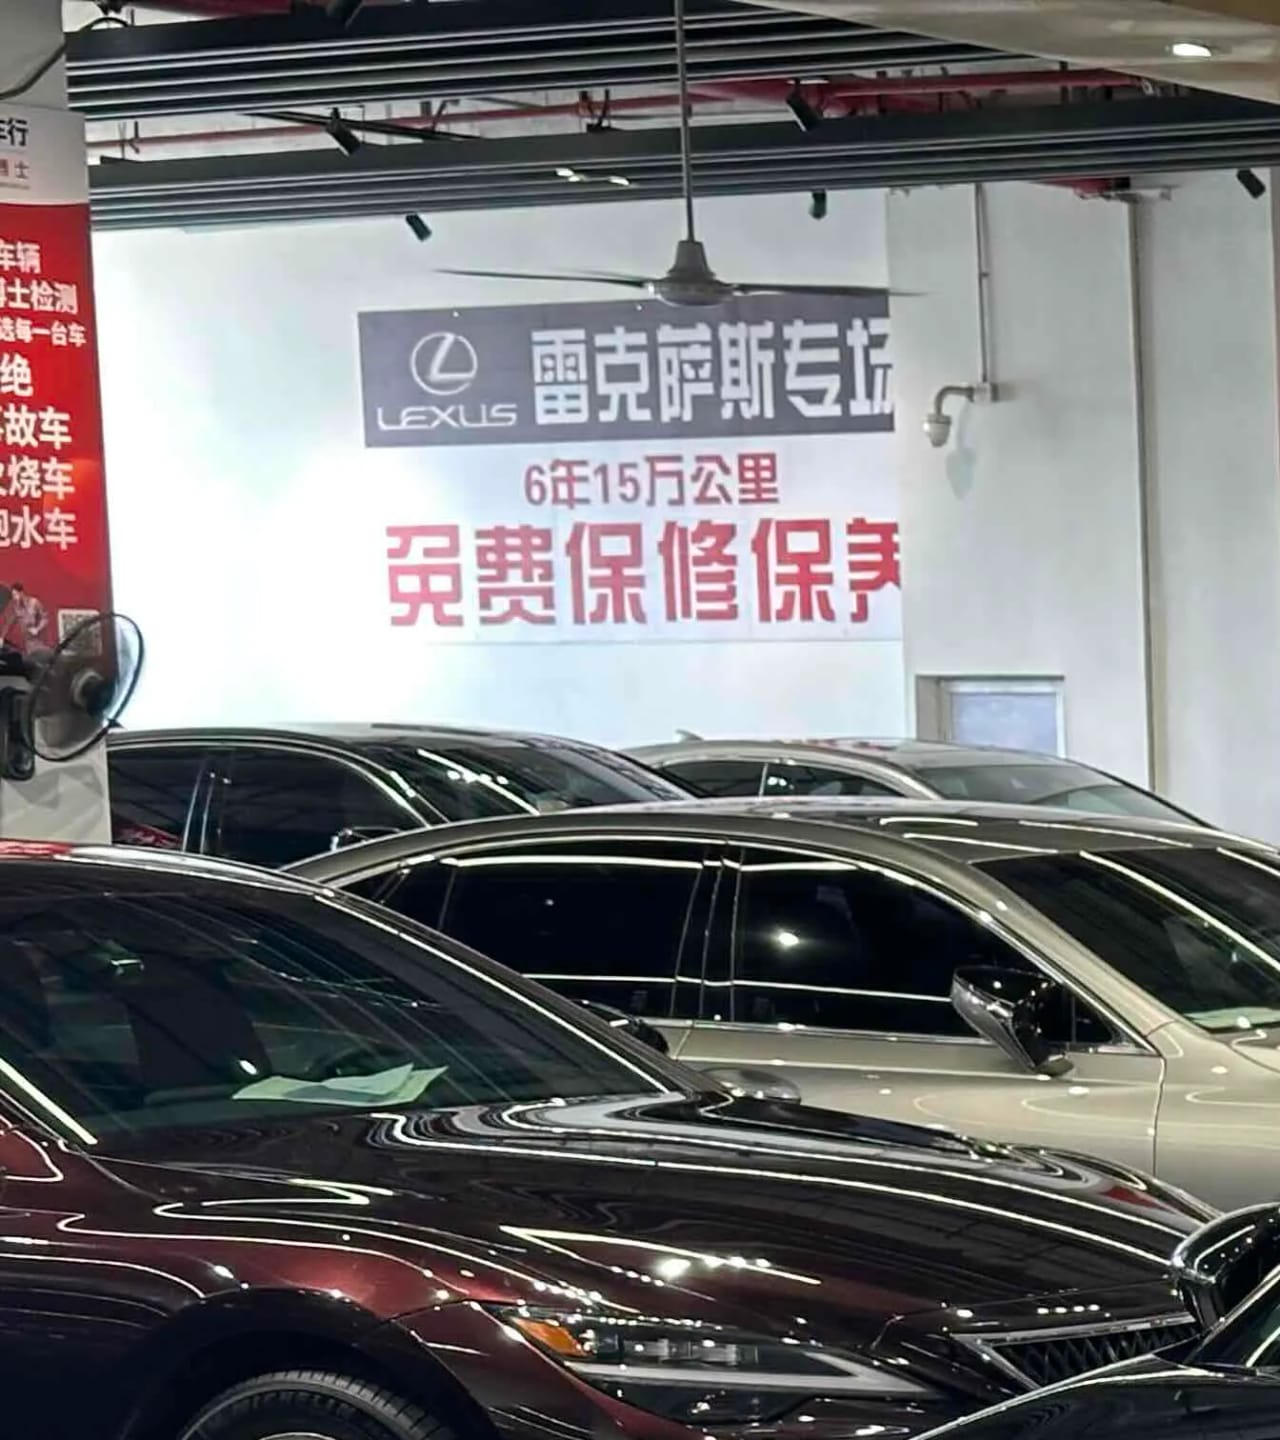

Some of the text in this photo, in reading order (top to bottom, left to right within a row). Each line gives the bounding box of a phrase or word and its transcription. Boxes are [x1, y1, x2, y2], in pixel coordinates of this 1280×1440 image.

[531, 317, 894, 425] 雷克萨斯专场
[0, 403, 72, 450] 故车
[377, 403, 519, 431] LEXUS
[0, 454, 75, 500] 烧车
[523, 452, 780, 509] 6年15万公里
[386, 517, 902, 627] 免费保修保养
